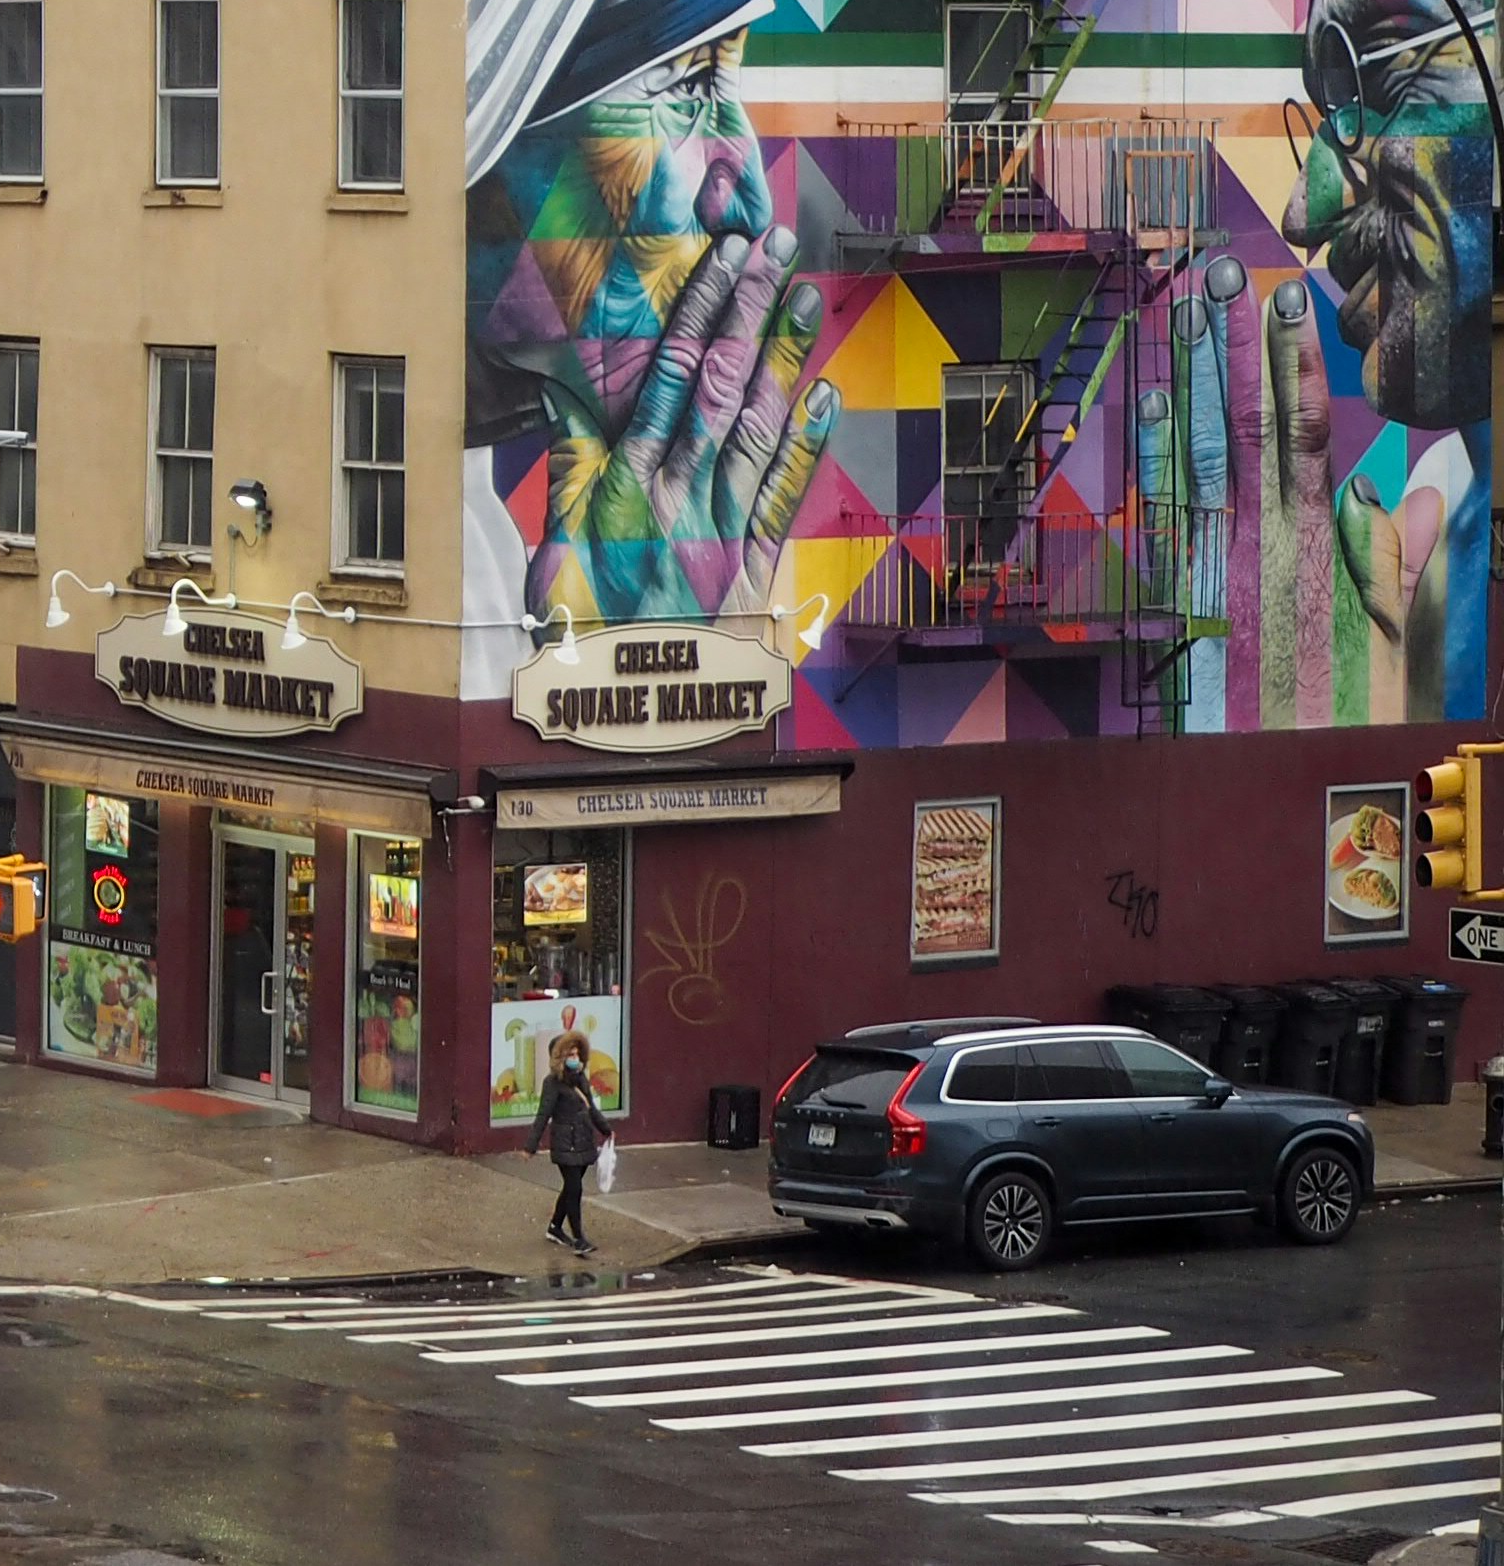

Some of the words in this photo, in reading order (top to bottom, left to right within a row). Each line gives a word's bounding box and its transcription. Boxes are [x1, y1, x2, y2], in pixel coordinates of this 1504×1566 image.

[184, 622, 265, 662] CHELSEA
[614, 640, 699, 674] CHELSEA
[119, 655, 216, 702] SQUARE
[222, 668, 334, 720] MARKET
[547, 685, 649, 731] SQUARE
[657, 681, 767, 724] MARKET
[136, 770, 185, 793] CHELSEA
[188, 778, 228, 800] SQUARE
[232, 784, 274, 807] MARKET
[511, 801, 533, 816] 130
[577, 793, 644, 814] CHELSEA
[650, 789, 704, 810] SQUARE
[709, 787, 768, 807] MARKET
[62, 928, 112, 950] BREAKFAST
[113, 939, 120, 950] &
[123, 939, 151, 957] LUNCH
[1467, 927, 1498, 948] ONE
